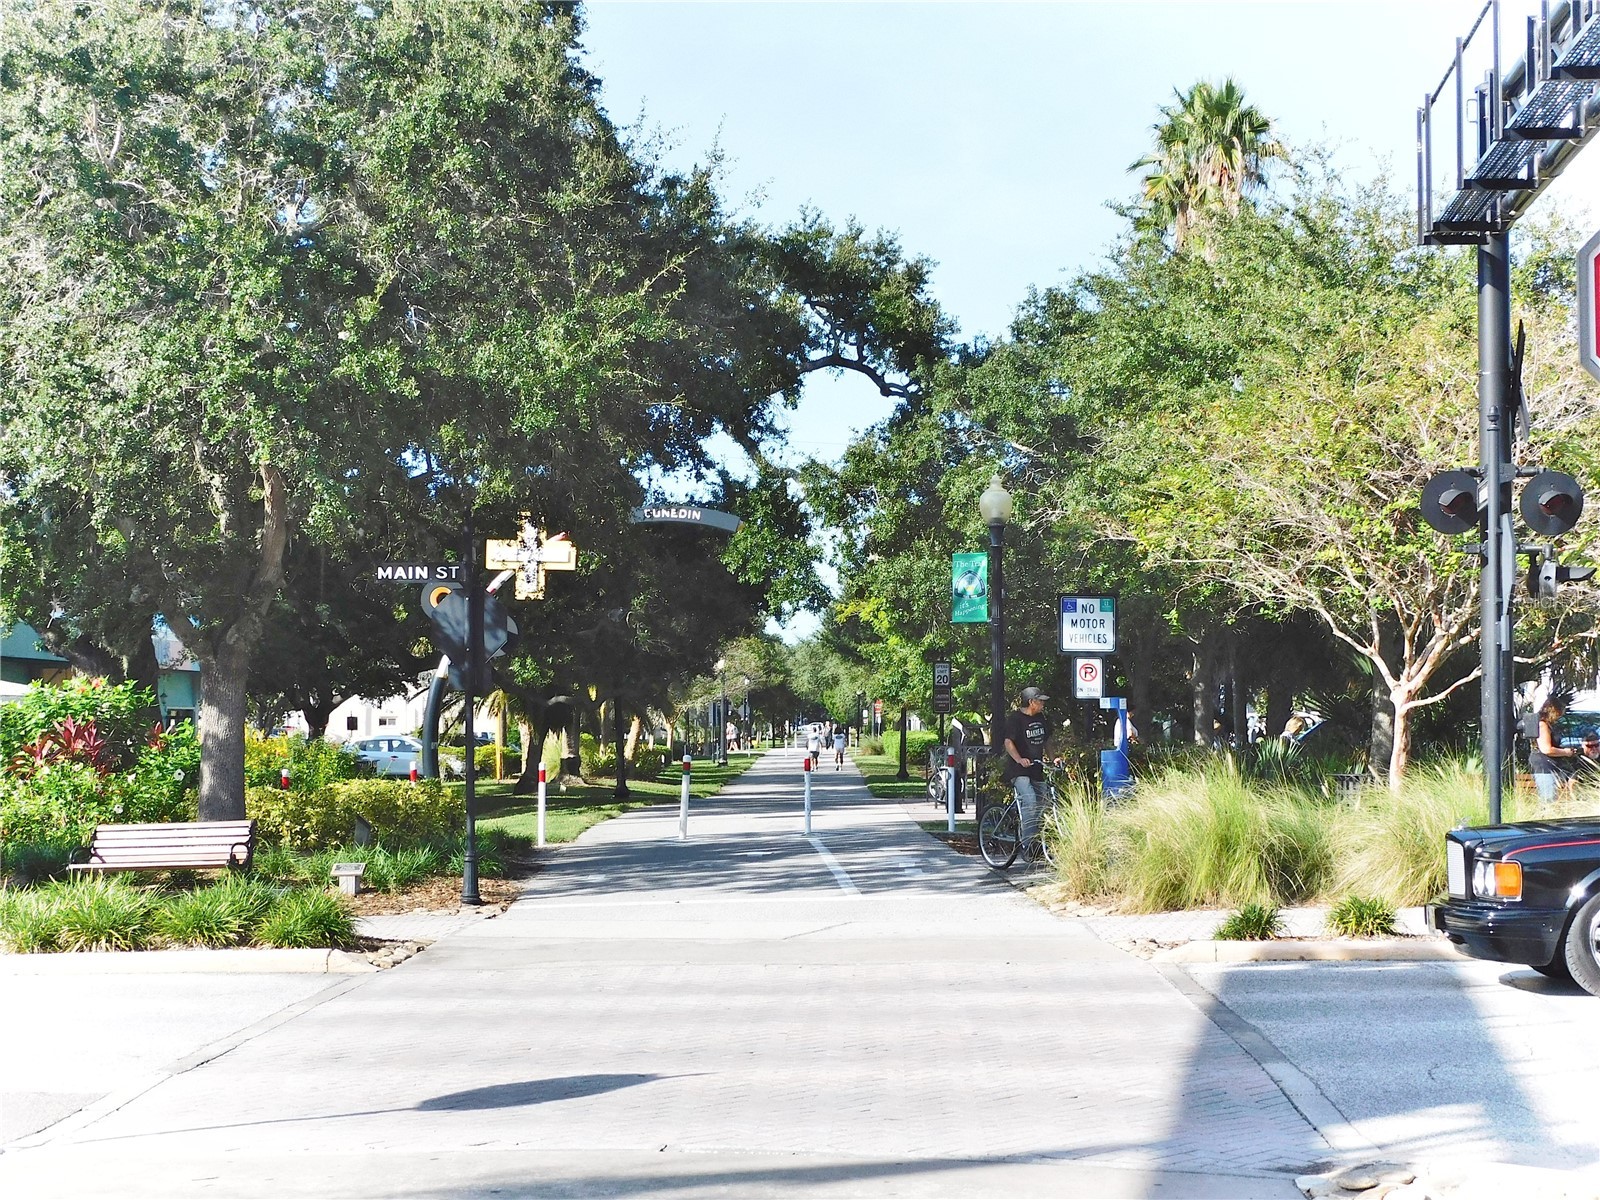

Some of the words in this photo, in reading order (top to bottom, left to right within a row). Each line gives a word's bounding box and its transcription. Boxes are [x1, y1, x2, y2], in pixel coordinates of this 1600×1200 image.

[955, 560, 969, 568] The
[377, 566, 429, 580] MAIN
[435, 566, 460, 579] ST
[1081, 603, 1095, 614] NO
[1070, 618, 1106, 629] MOTOR
[1069, 633, 1108, 644] VEHICLES
[936, 674, 949, 684] 20
